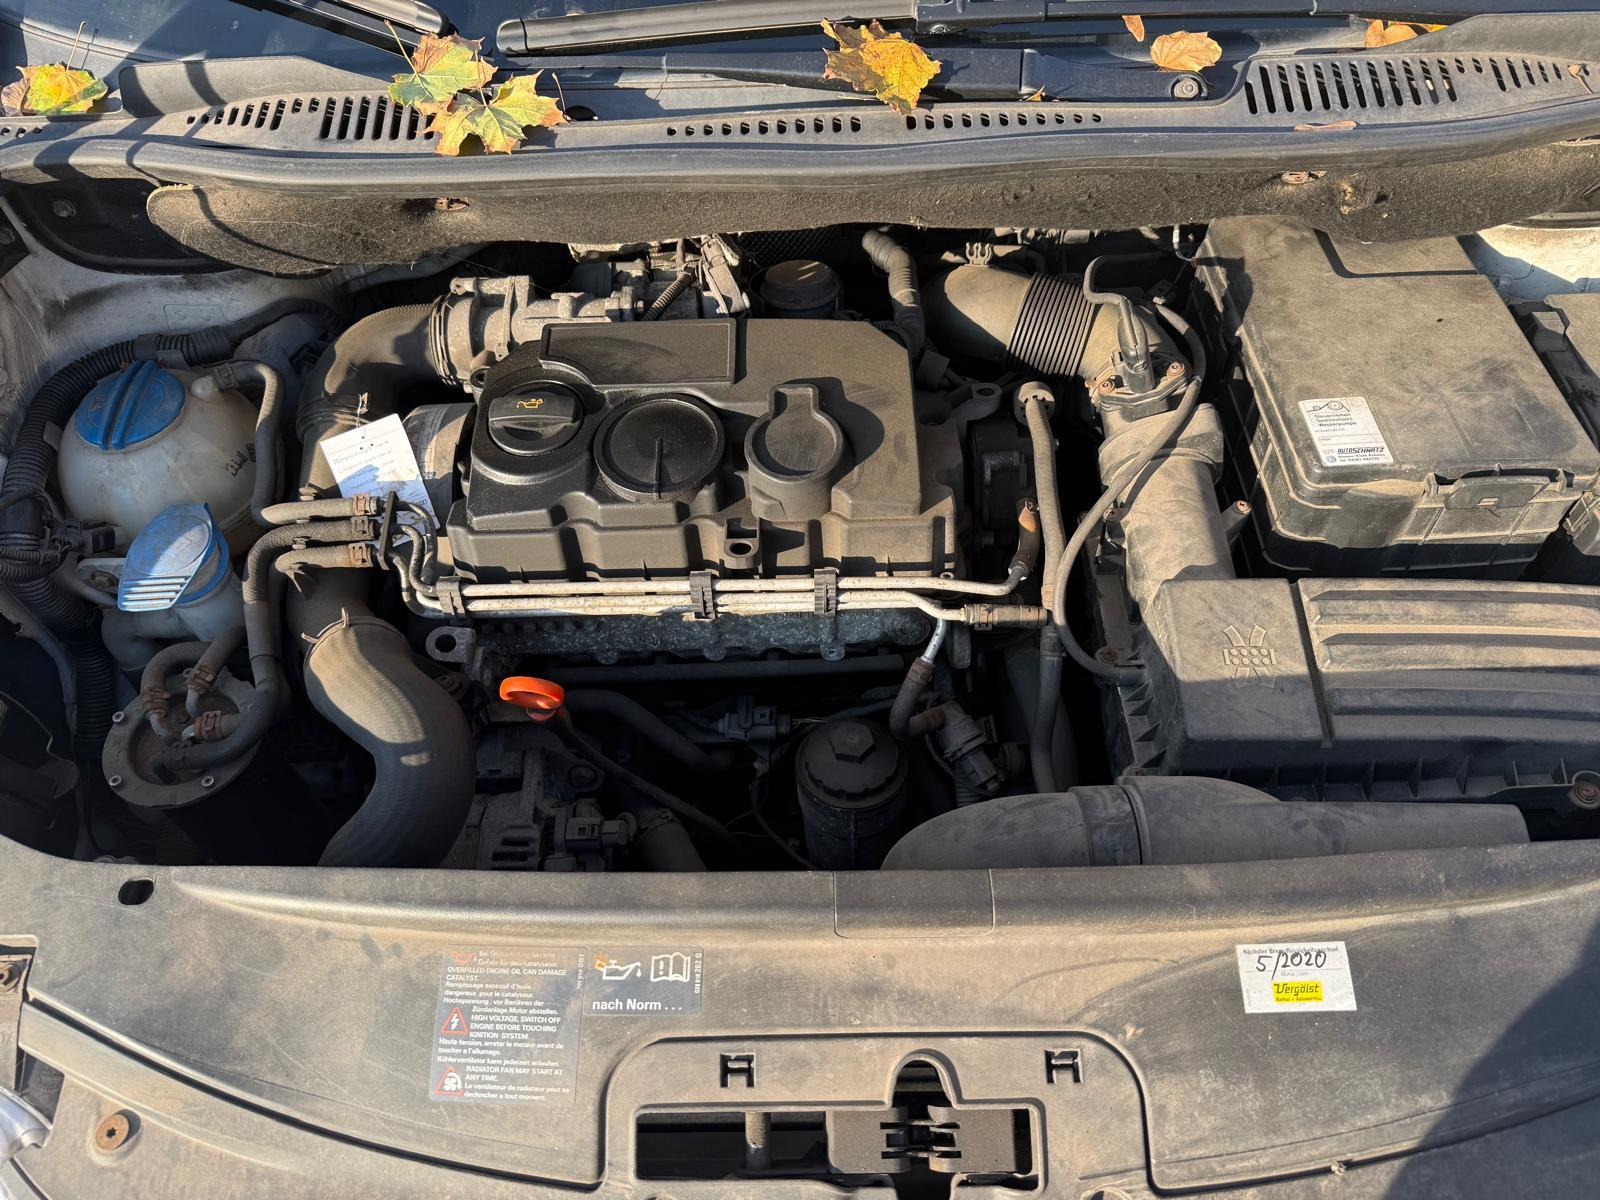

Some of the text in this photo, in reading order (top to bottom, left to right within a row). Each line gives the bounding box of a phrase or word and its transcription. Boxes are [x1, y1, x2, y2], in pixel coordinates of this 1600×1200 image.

[1274, 983, 1319, 996] Vergölst
[472, 1006, 507, 1014] Zündanlage
[592, 999, 623, 1010] nach
[626, 999, 662, 1010] Norm
